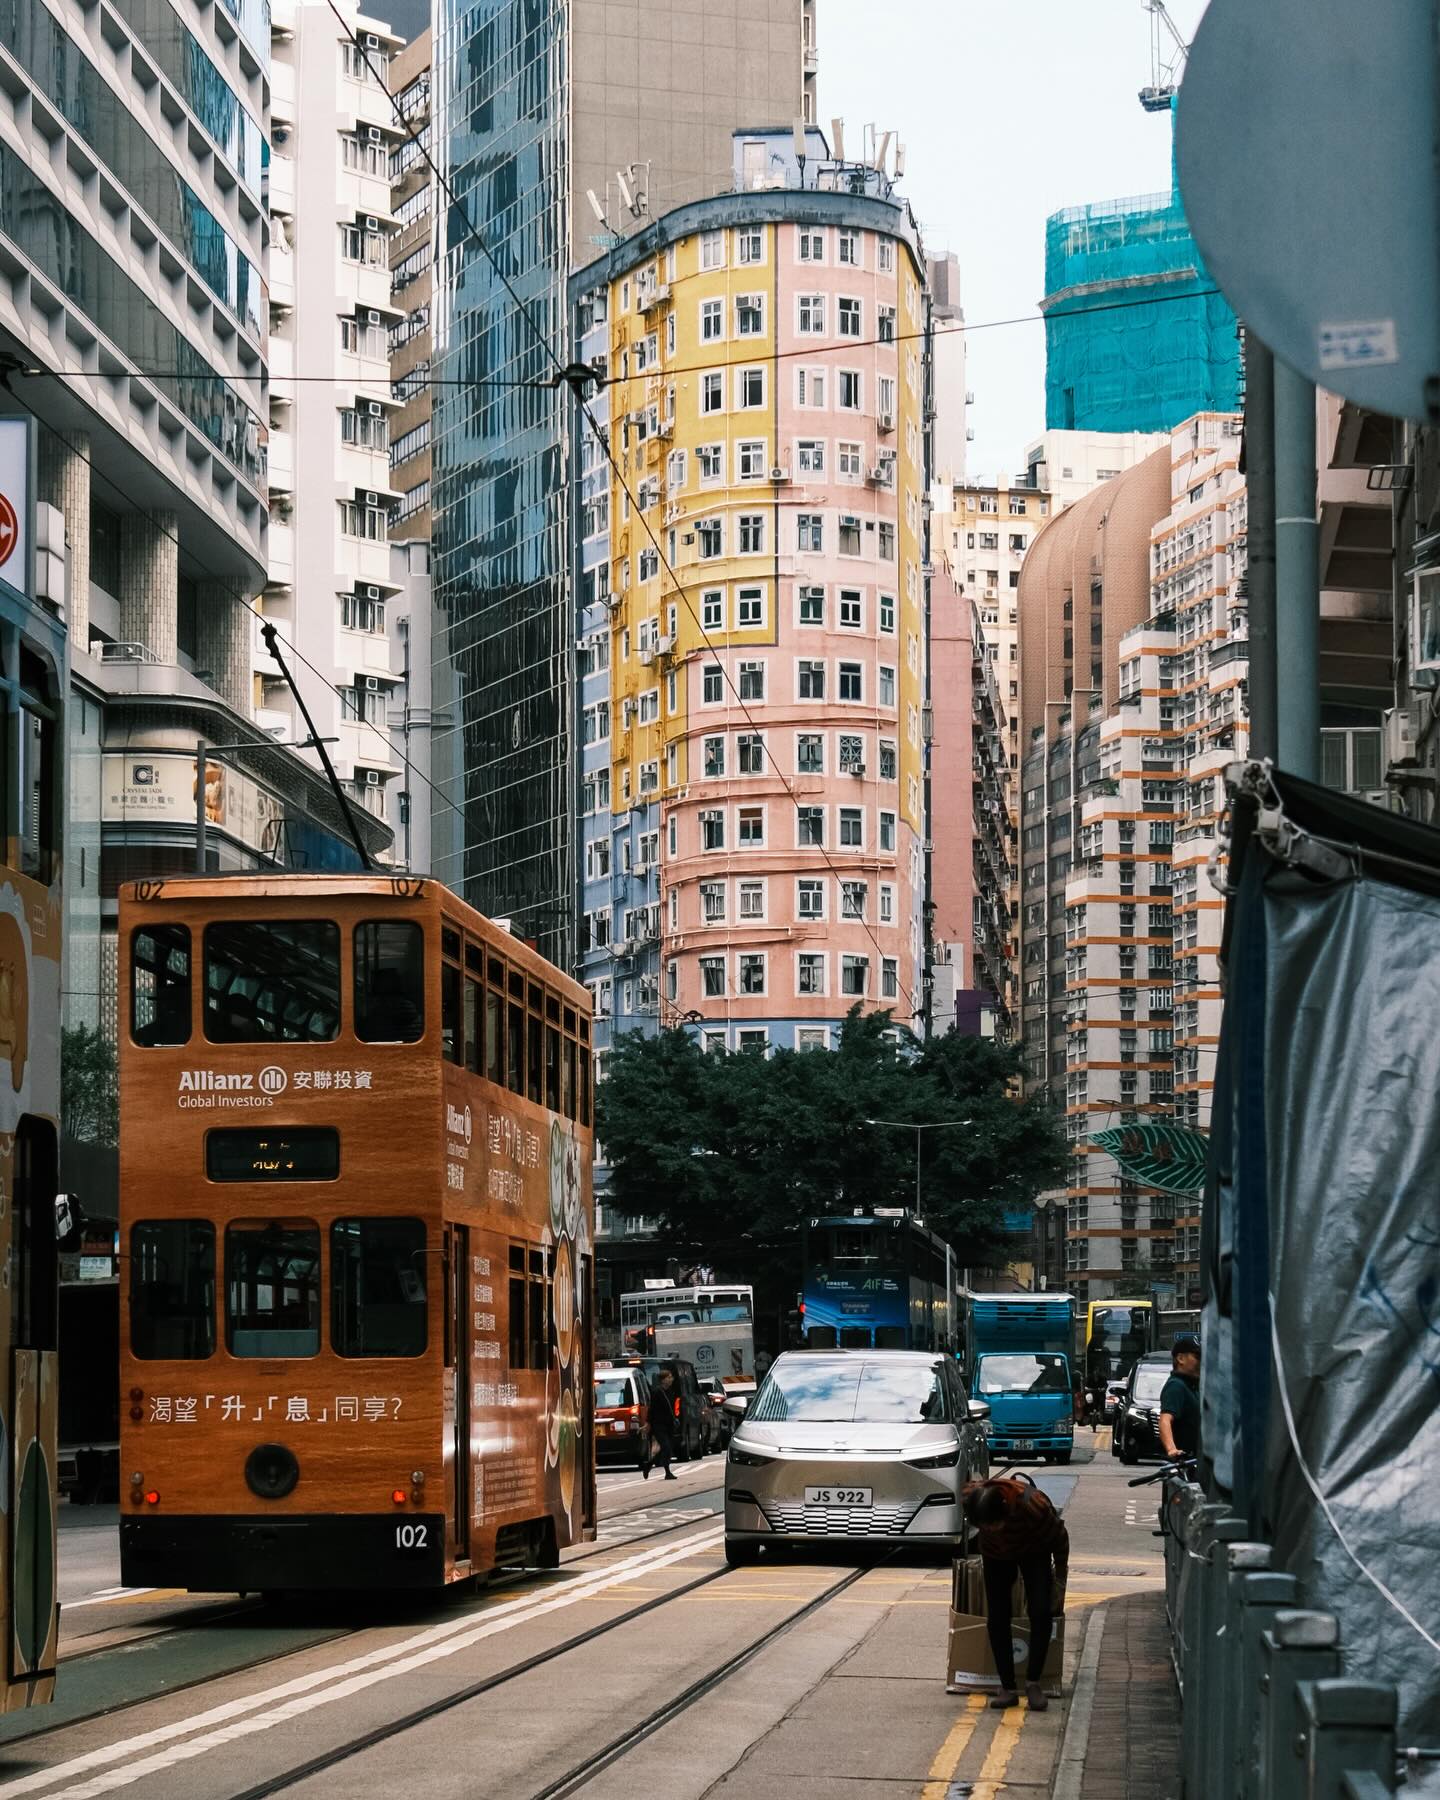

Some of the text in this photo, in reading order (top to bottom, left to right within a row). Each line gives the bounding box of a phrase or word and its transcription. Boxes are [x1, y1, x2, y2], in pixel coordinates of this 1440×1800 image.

[134, 881, 166, 901] 102
[390, 879, 425, 898] 102
[178, 1070, 253, 1091] Allianz
[293, 1071, 373, 1090] 安聯投資
[178, 1094, 274, 1108] Global Investors
[811, 1219, 819, 1228] 17
[893, 1219, 901, 1228] 17
[812, 1491, 865, 1503] JS 922
[396, 1524, 427, 1549] 102
